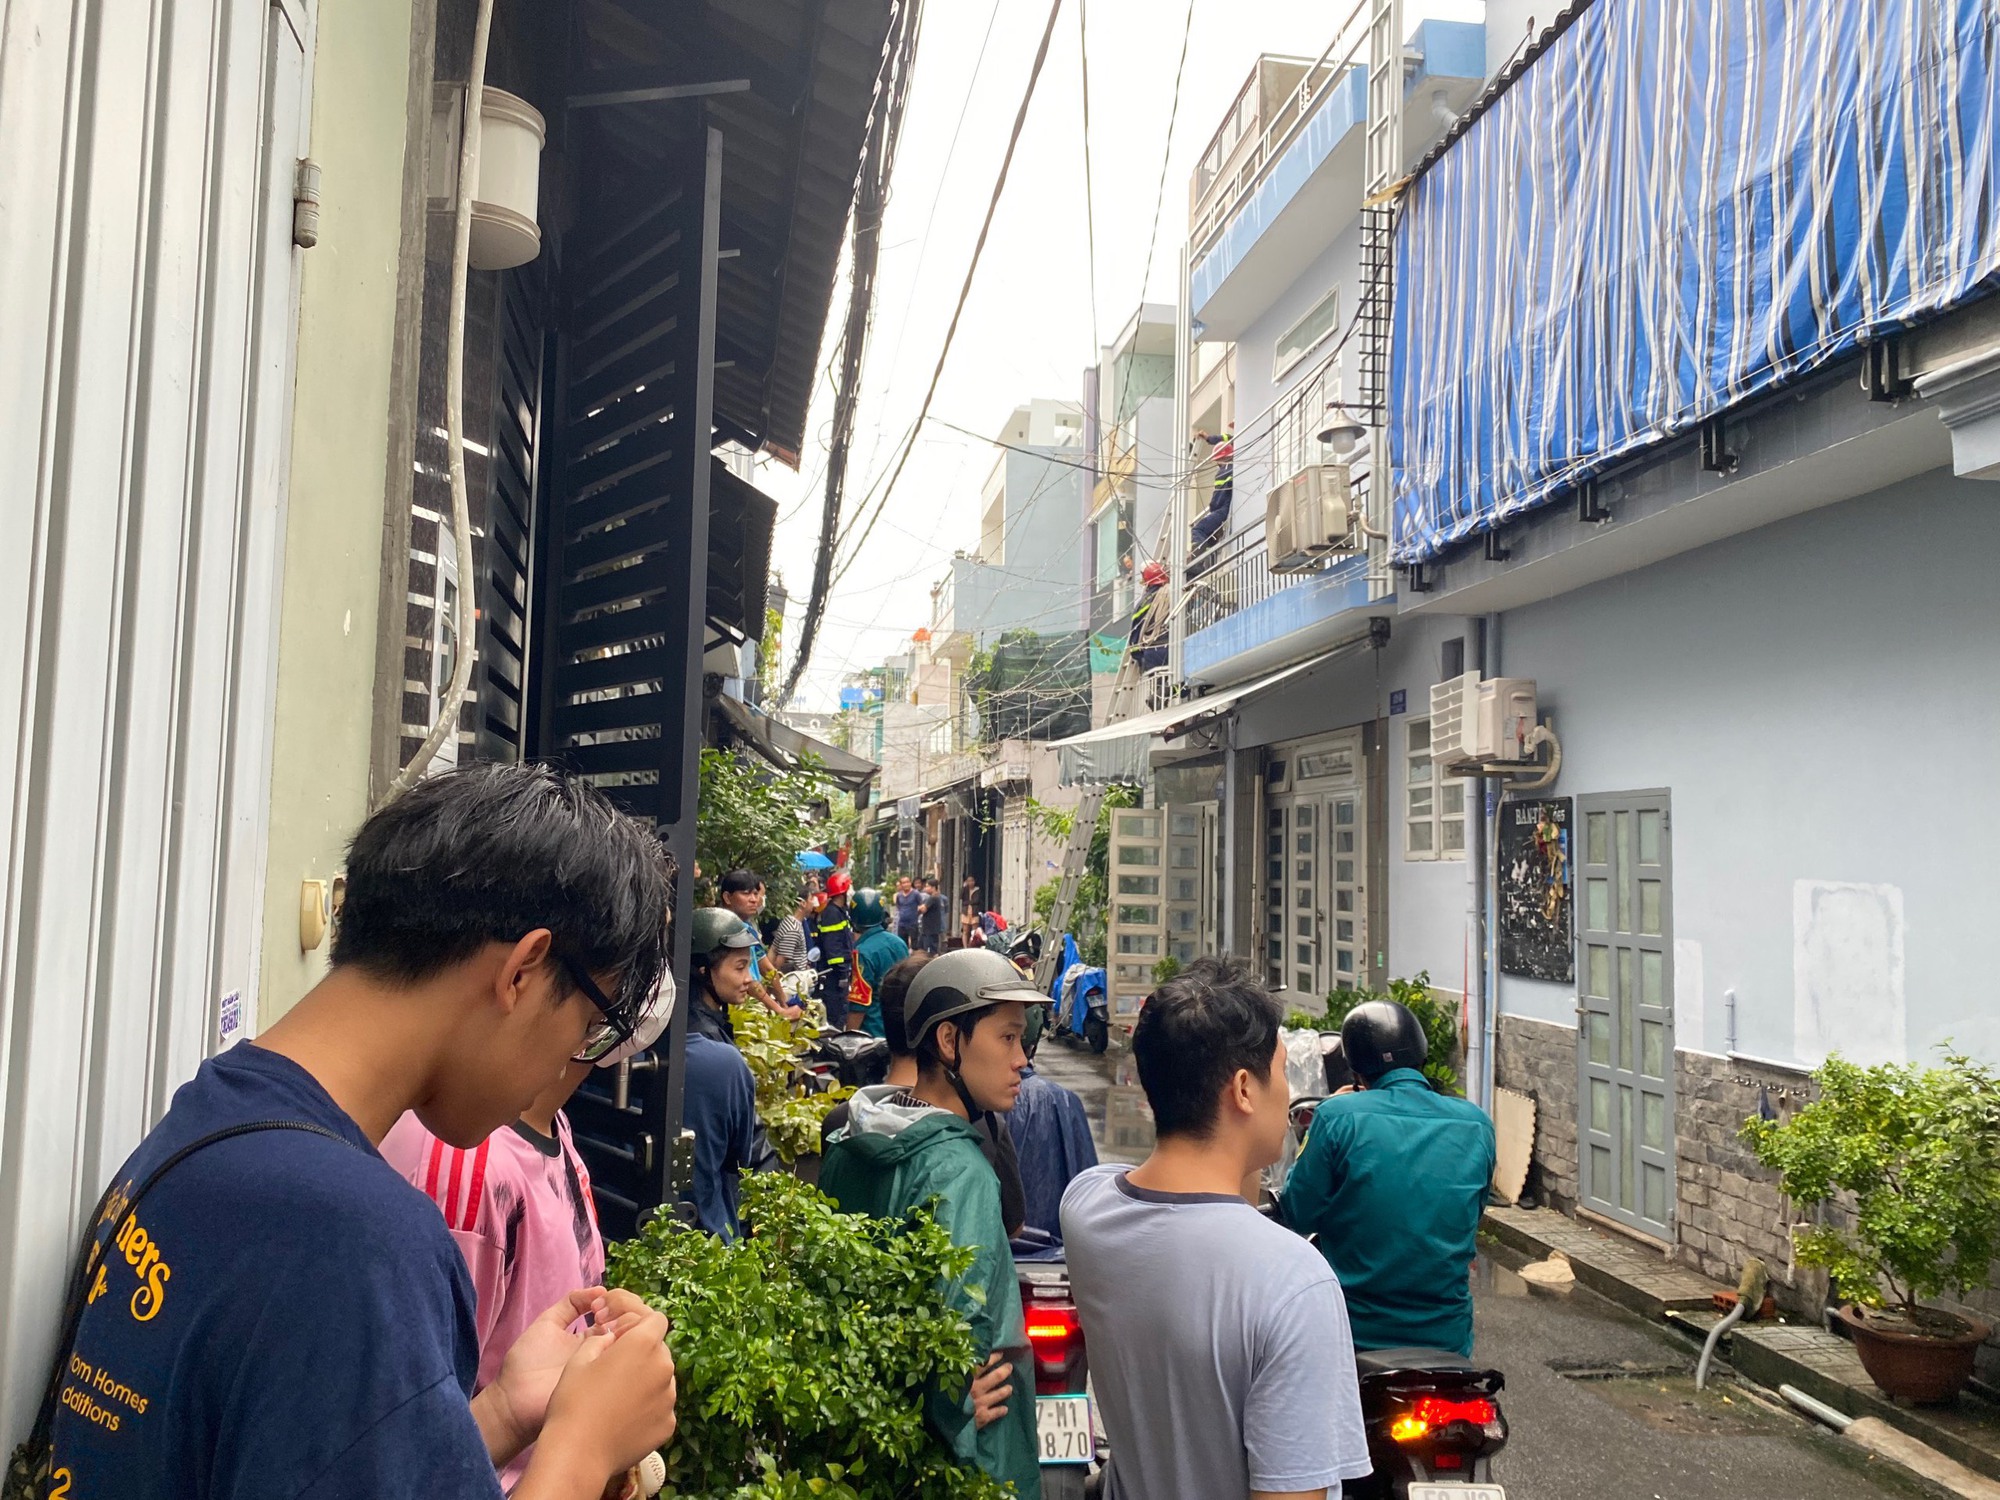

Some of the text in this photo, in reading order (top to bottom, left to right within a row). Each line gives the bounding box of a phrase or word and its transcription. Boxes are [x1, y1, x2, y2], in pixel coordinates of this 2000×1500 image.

[71, 1352, 148, 1414] om Homes
[62, 1385, 120, 1431] dditions
[1036, 1401, 1077, 1428] 7-M1
[1038, 1431, 1088, 1458] 8.70
